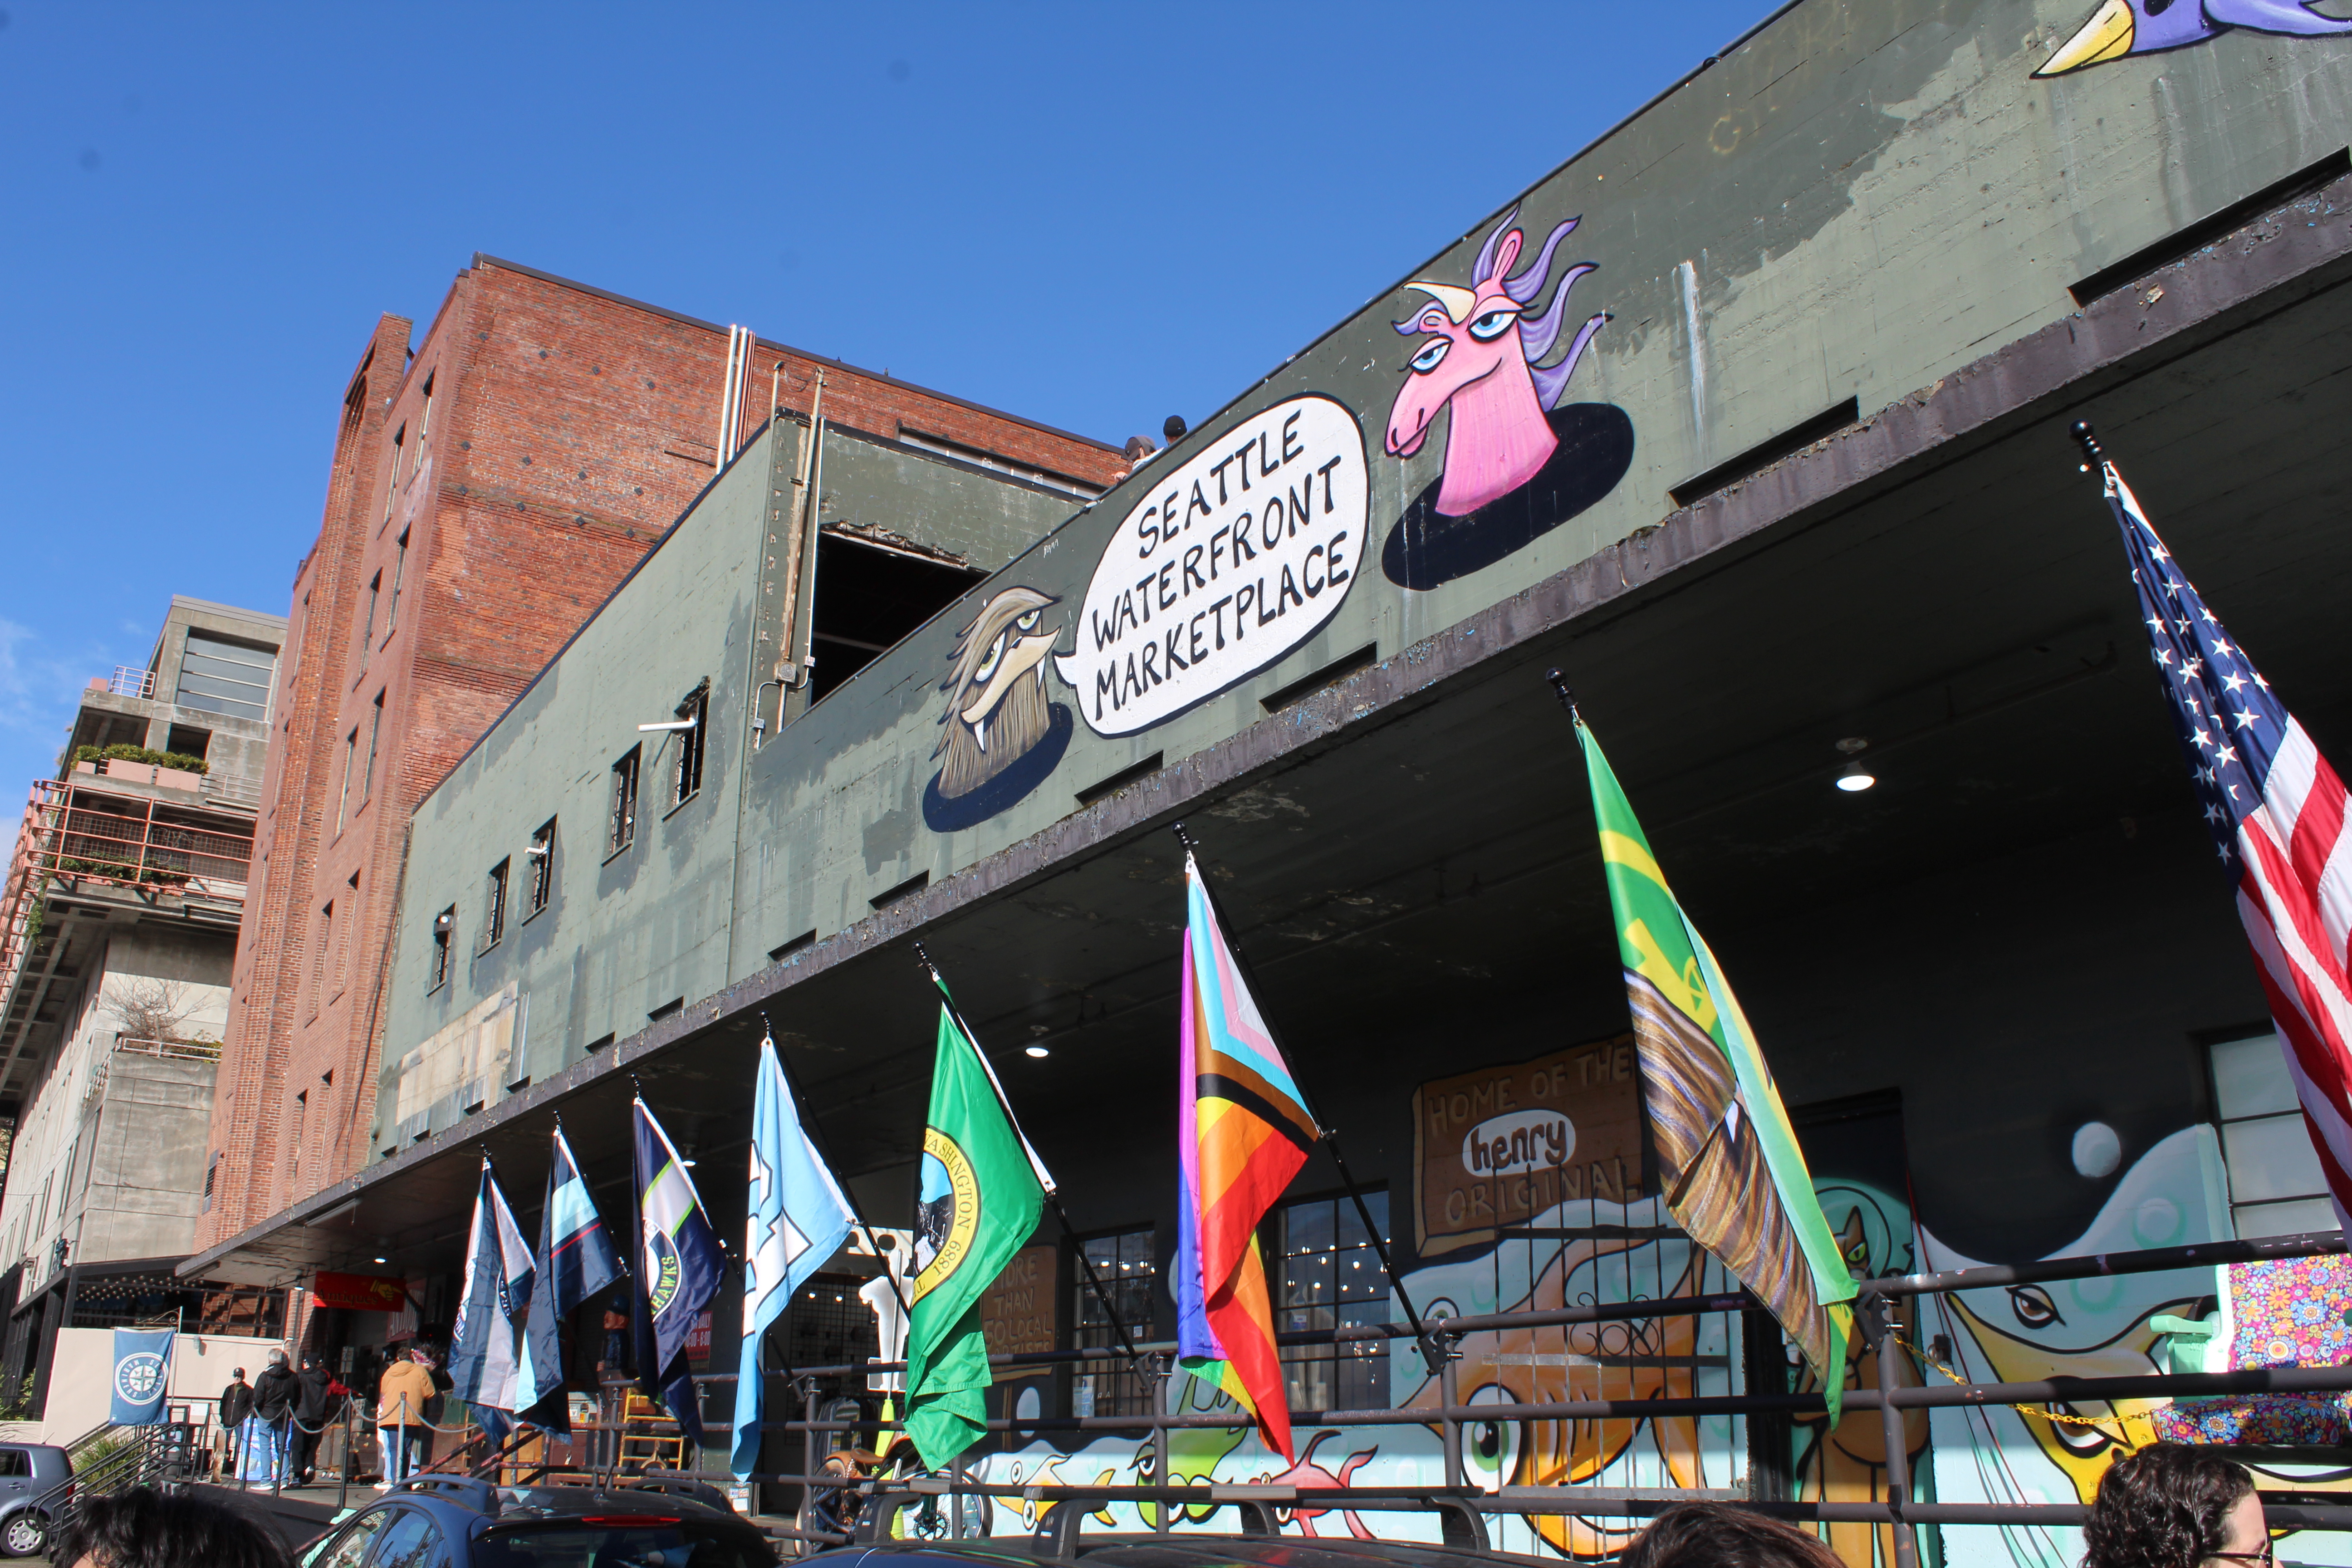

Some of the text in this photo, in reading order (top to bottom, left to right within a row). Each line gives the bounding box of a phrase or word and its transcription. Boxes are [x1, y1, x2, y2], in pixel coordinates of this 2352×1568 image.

[1139, 409, 1304, 558] SEATTLE
[1093, 456, 1341, 652] WATERFRONT
[1095, 532, 1348, 720] MARKETPLACE
[1430, 1042, 1633, 1138] HOME OF THE
[1470, 1120, 1566, 1172] henry
[1446, 1156, 1642, 1226] ORIGINAL
[932, 1240, 961, 1277] 1889
[314, 1288, 378, 1308] Antiques
[994, 1286, 1034, 1317] THAN
[699, 1313, 711, 1329] DAILY
[700, 1331, 710, 1347] 6:00
[983, 1312, 1053, 1352] 50 LOCAL
[121, 1359, 140, 1398] MARINERS
